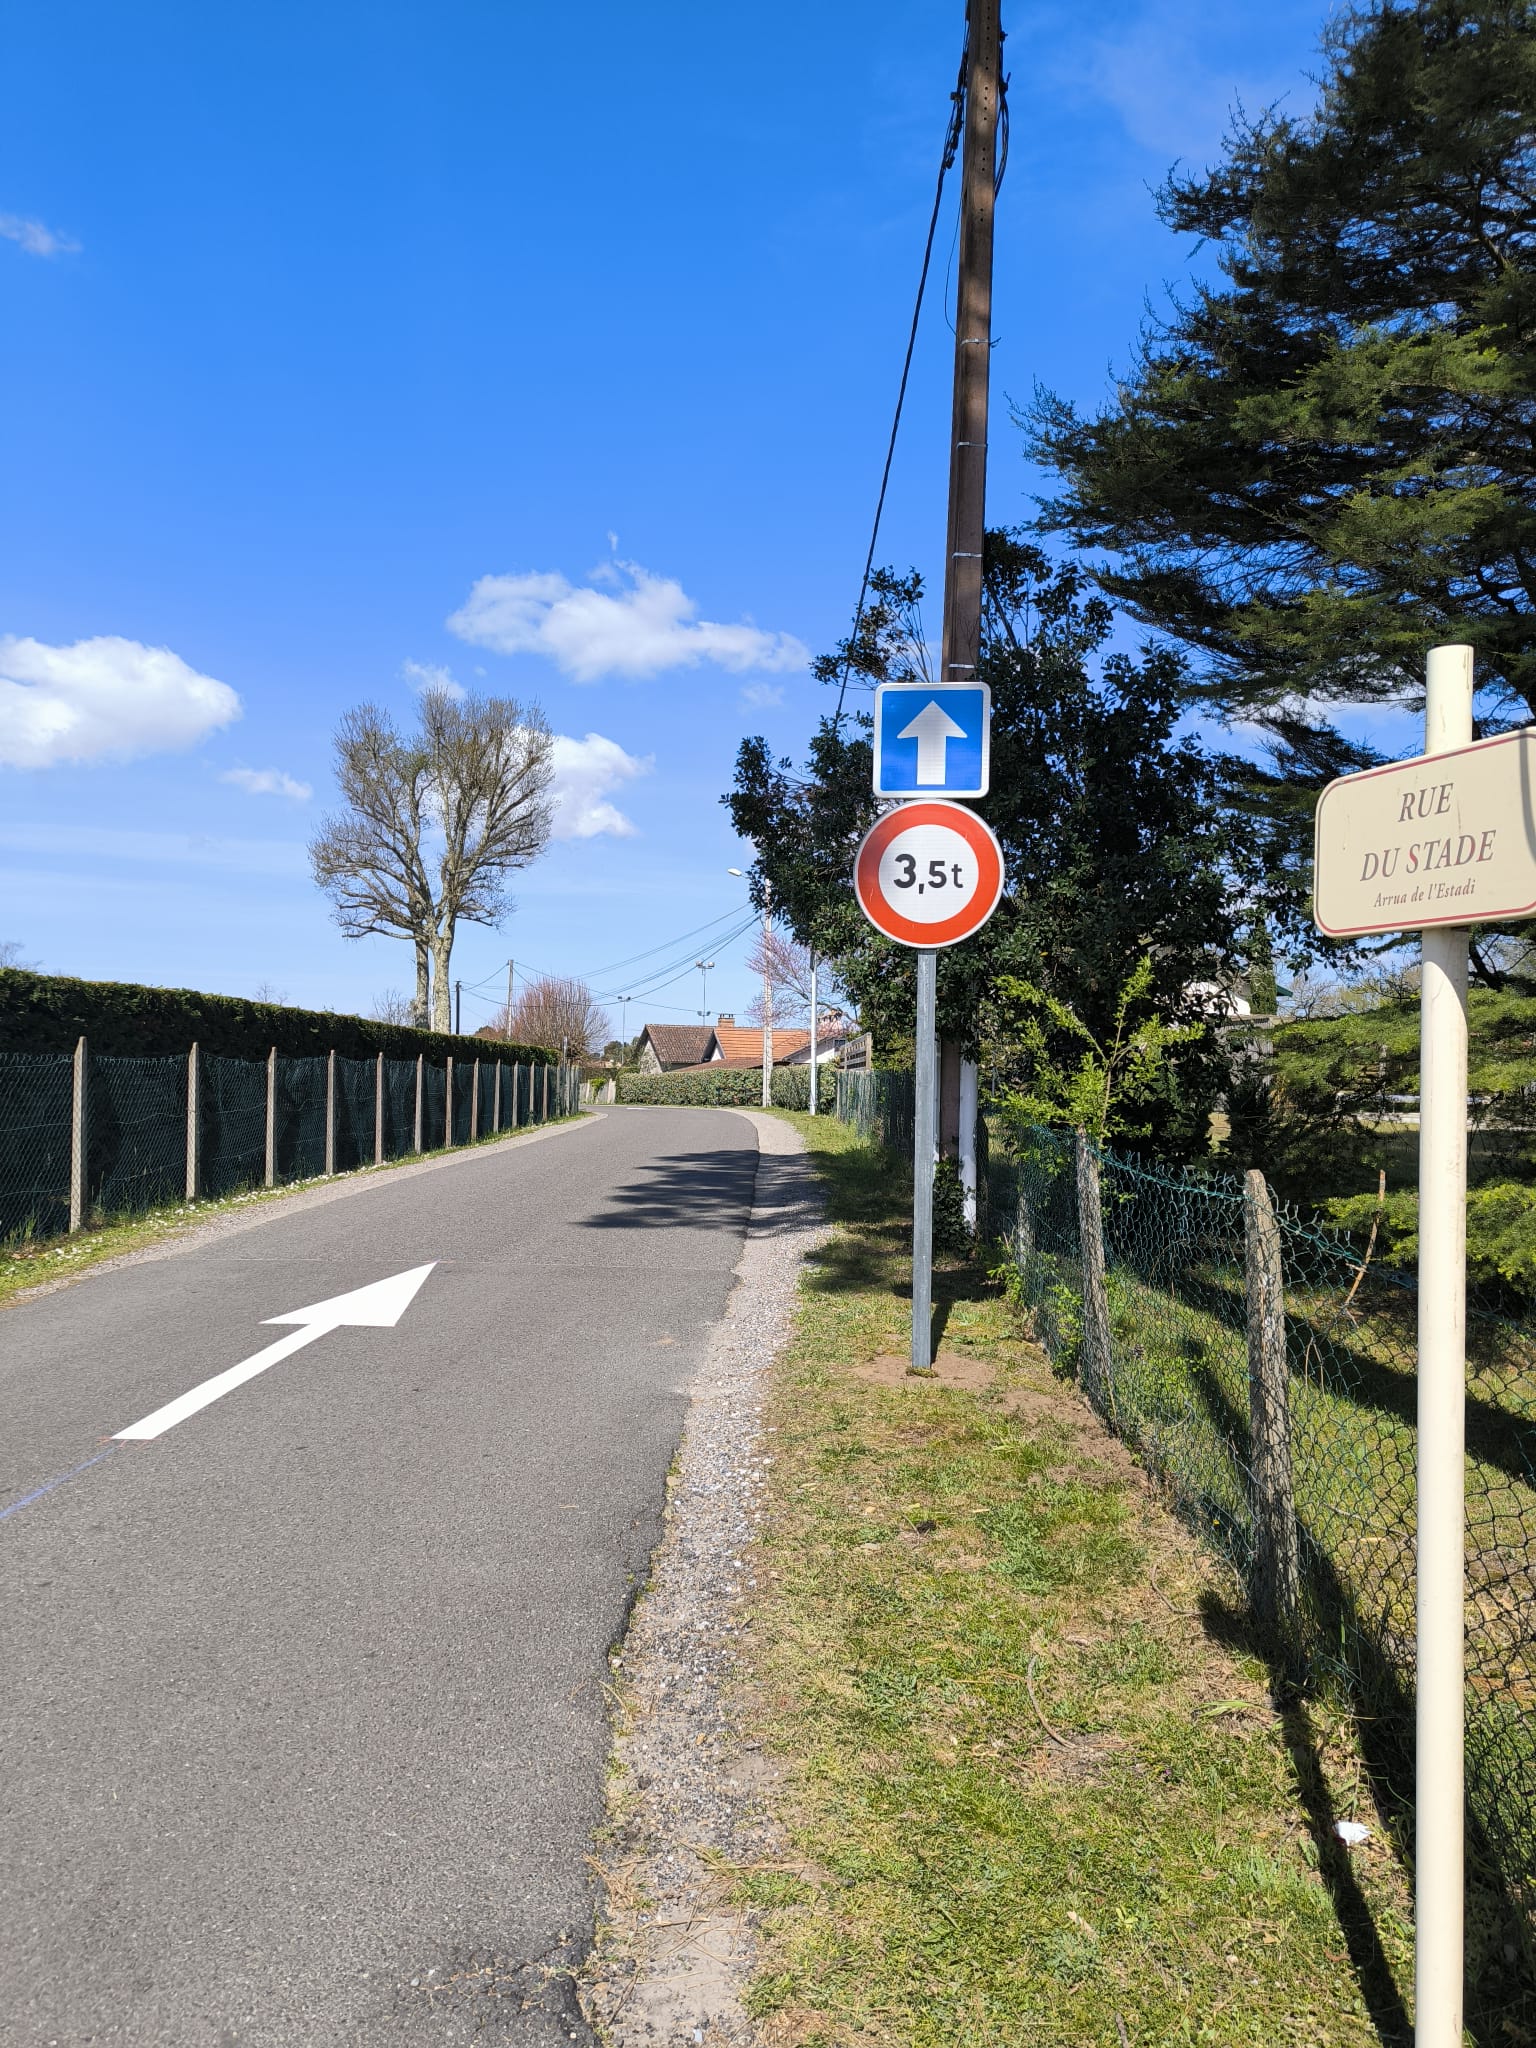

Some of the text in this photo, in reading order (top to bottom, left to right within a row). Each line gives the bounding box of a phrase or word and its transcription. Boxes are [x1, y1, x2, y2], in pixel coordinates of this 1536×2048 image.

[1398, 782, 1454, 822] RUE
[1359, 829, 1497, 881] DU STADE
[1373, 878, 1476, 907] Arrua de l'Estadi
